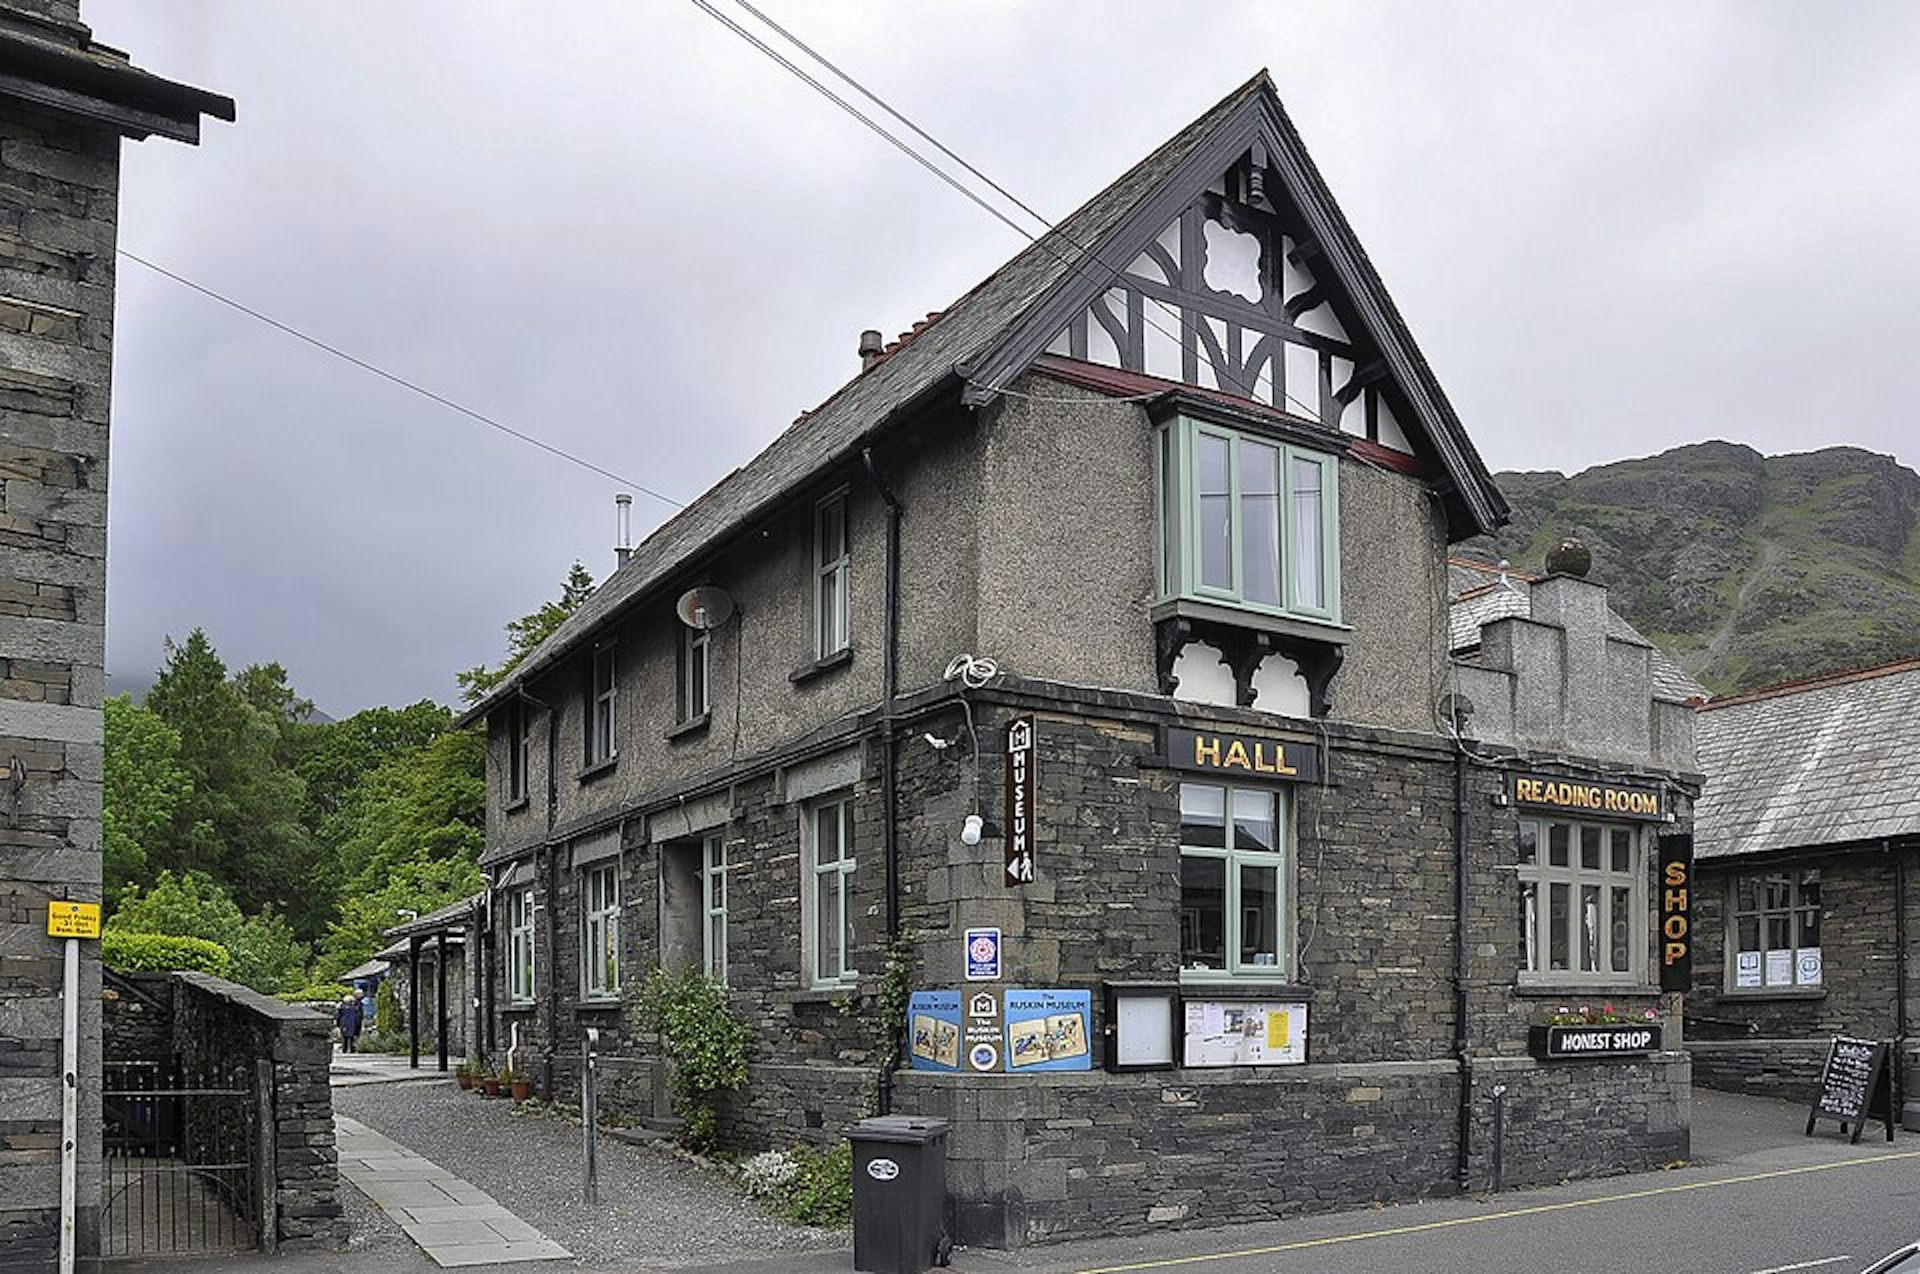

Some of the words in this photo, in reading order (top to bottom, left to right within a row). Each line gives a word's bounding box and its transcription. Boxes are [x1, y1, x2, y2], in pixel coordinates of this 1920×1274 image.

[1195, 735, 1298, 776] HALL
[1013, 751, 1026, 851] MUSEUM
[1516, 778, 1601, 808] READING
[1604, 788, 1657, 815] ROOM
[1664, 862, 1687, 966] SHOP
[1009, 1001, 1044, 1010] RUSKIN
[1046, 1001, 1086, 1010] MUSEUM
[975, 1018, 992, 1026] The
[965, 1035, 1003, 1043] MUSEUM
[1561, 1033, 1612, 1051] HONEST
[1613, 1031, 1652, 1049] SHOP
